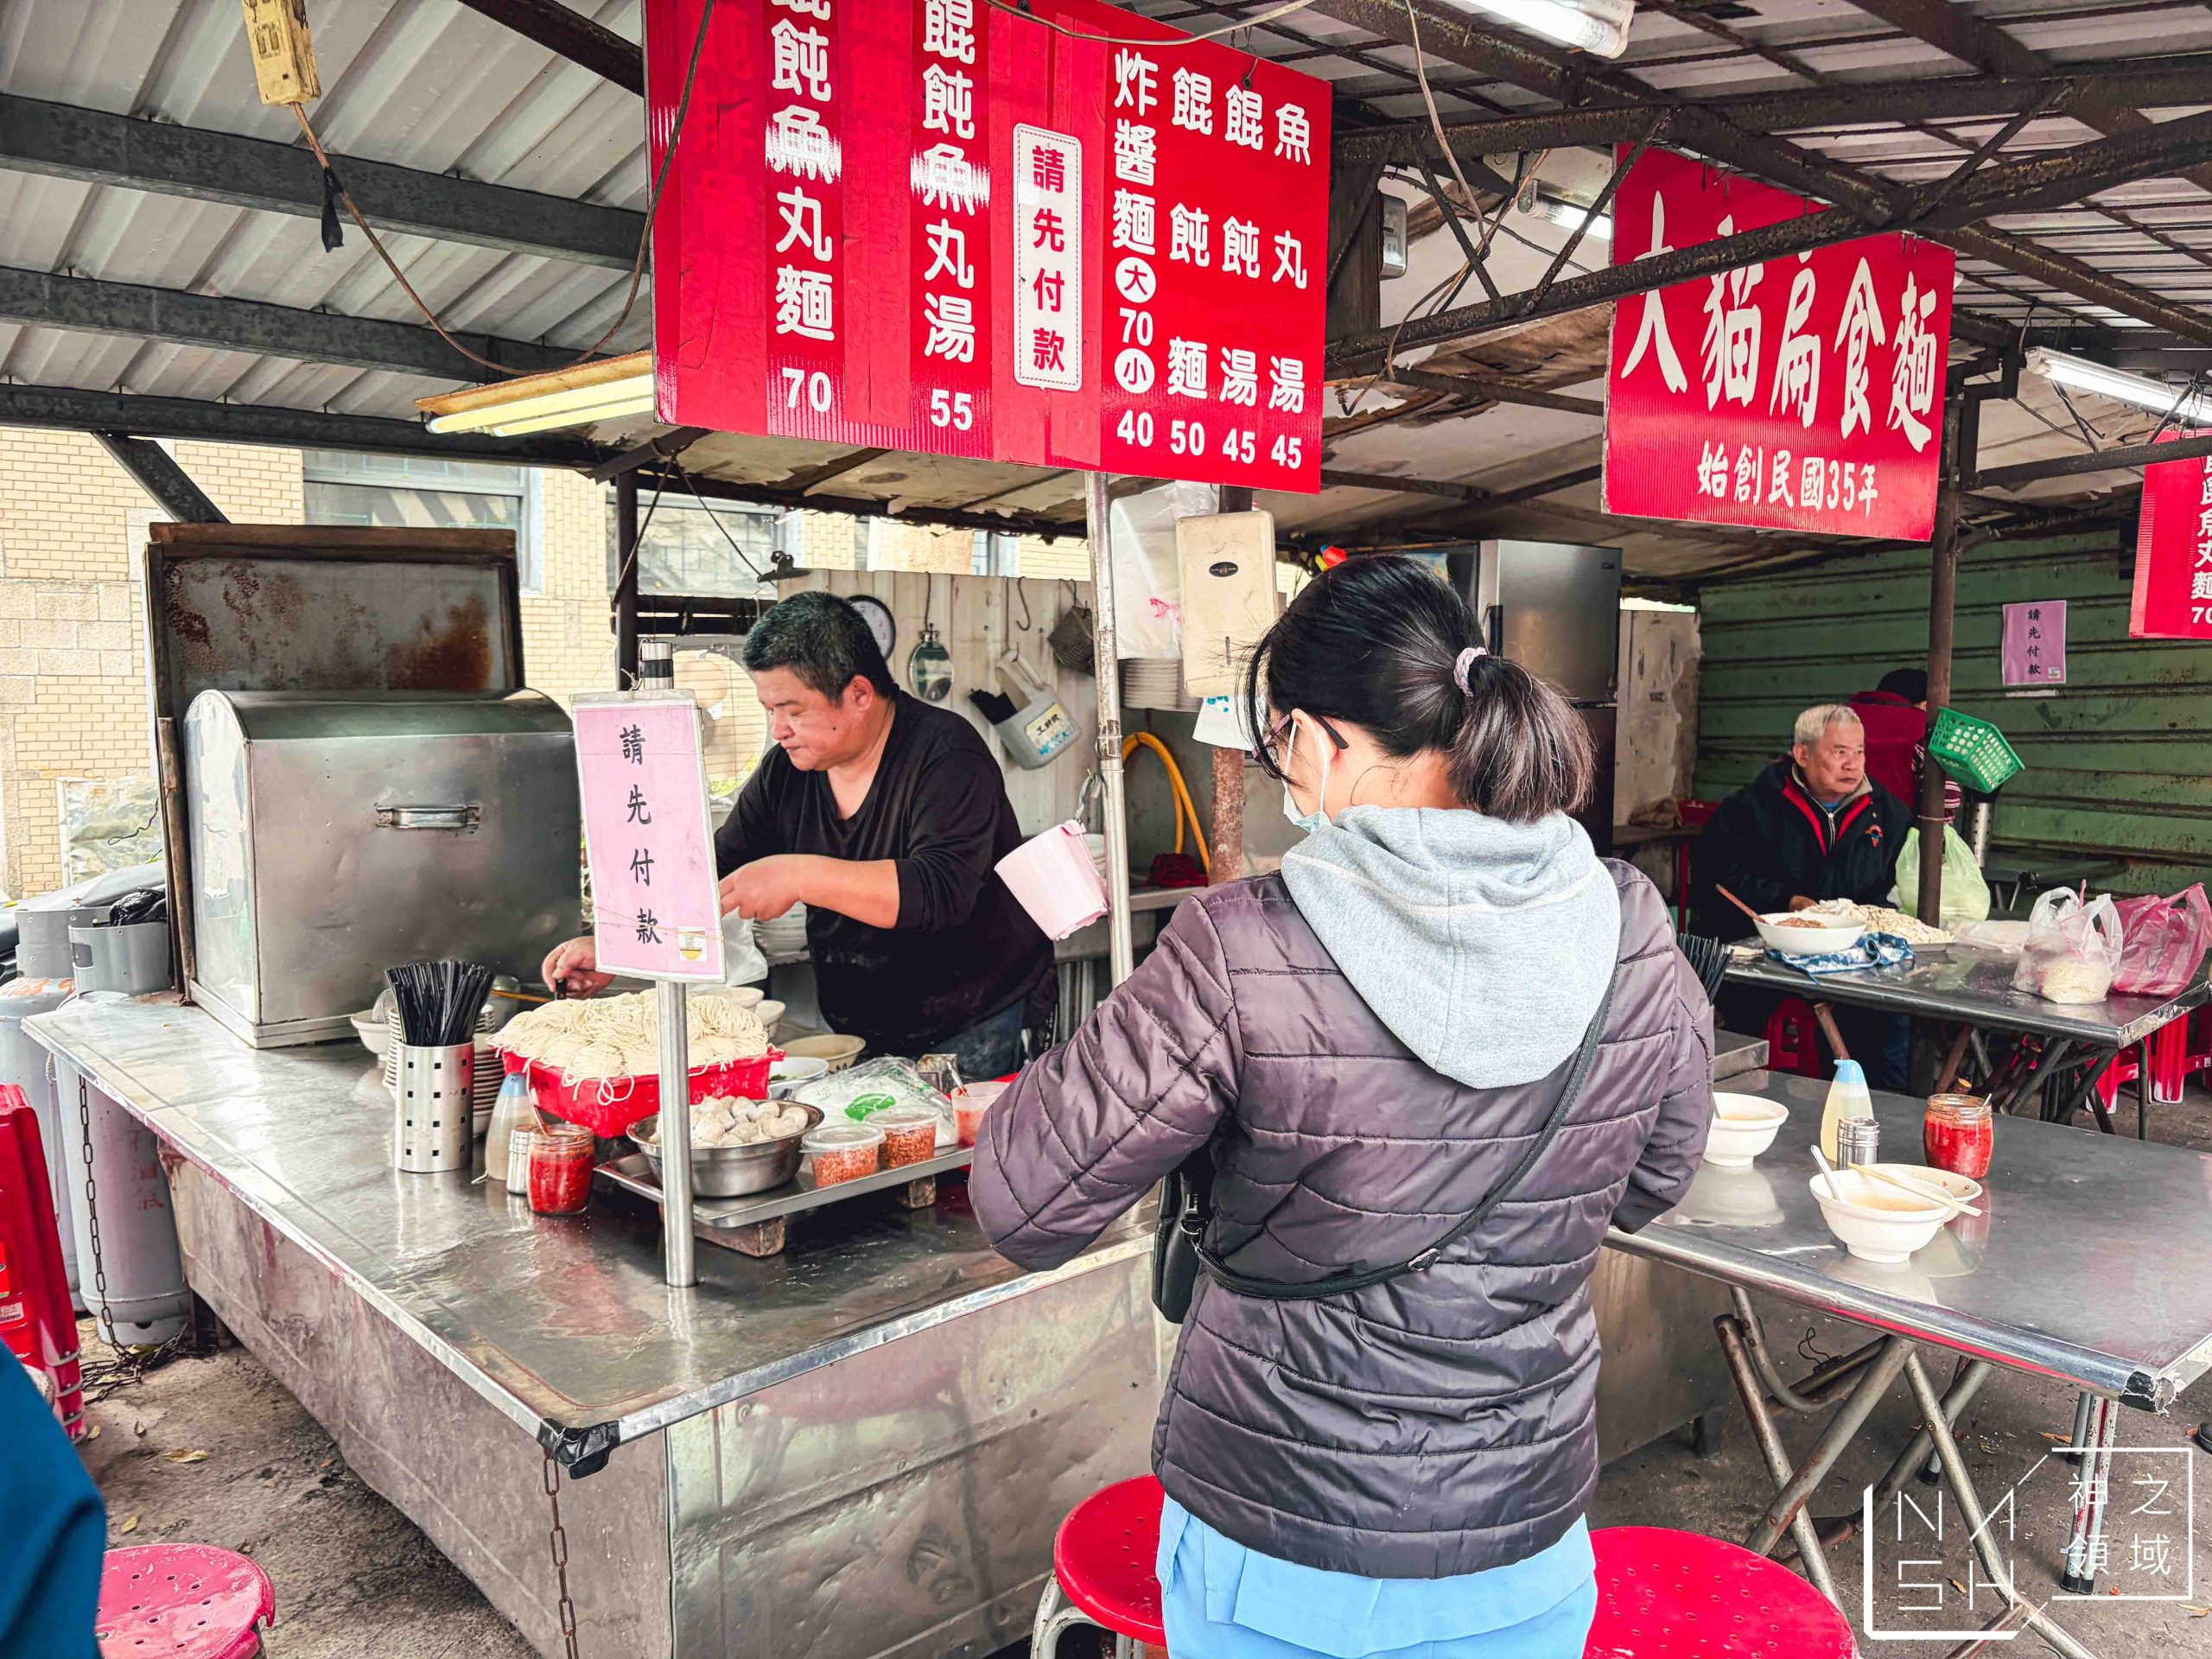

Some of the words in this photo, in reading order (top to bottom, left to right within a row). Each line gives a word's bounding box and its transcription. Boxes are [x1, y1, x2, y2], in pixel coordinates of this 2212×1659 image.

[771, 0, 835, 342] 飩魚丸麵
[1112, 48, 1159, 256] 炸醬麵
[1033, 145, 1065, 373] 請先付款
[1166, 67, 1212, 400] 餛飩麵
[1219, 84, 1263, 408] 餛飩湯
[1268, 103, 1312, 414] 魚丸湯
[1119, 308, 1154, 346] 70
[782, 367, 832, 412] 70
[931, 389, 973, 431] 55
[1116, 410, 1154, 448] 40
[1170, 420, 1205, 456] 50
[1222, 429, 1255, 464] 45
[1270, 435, 1302, 469] 45
[1696, 439, 1878, 516] 始創民國35年
[2026, 608, 2042, 675] 請先付款
[619, 724, 664, 945] 請先付款
